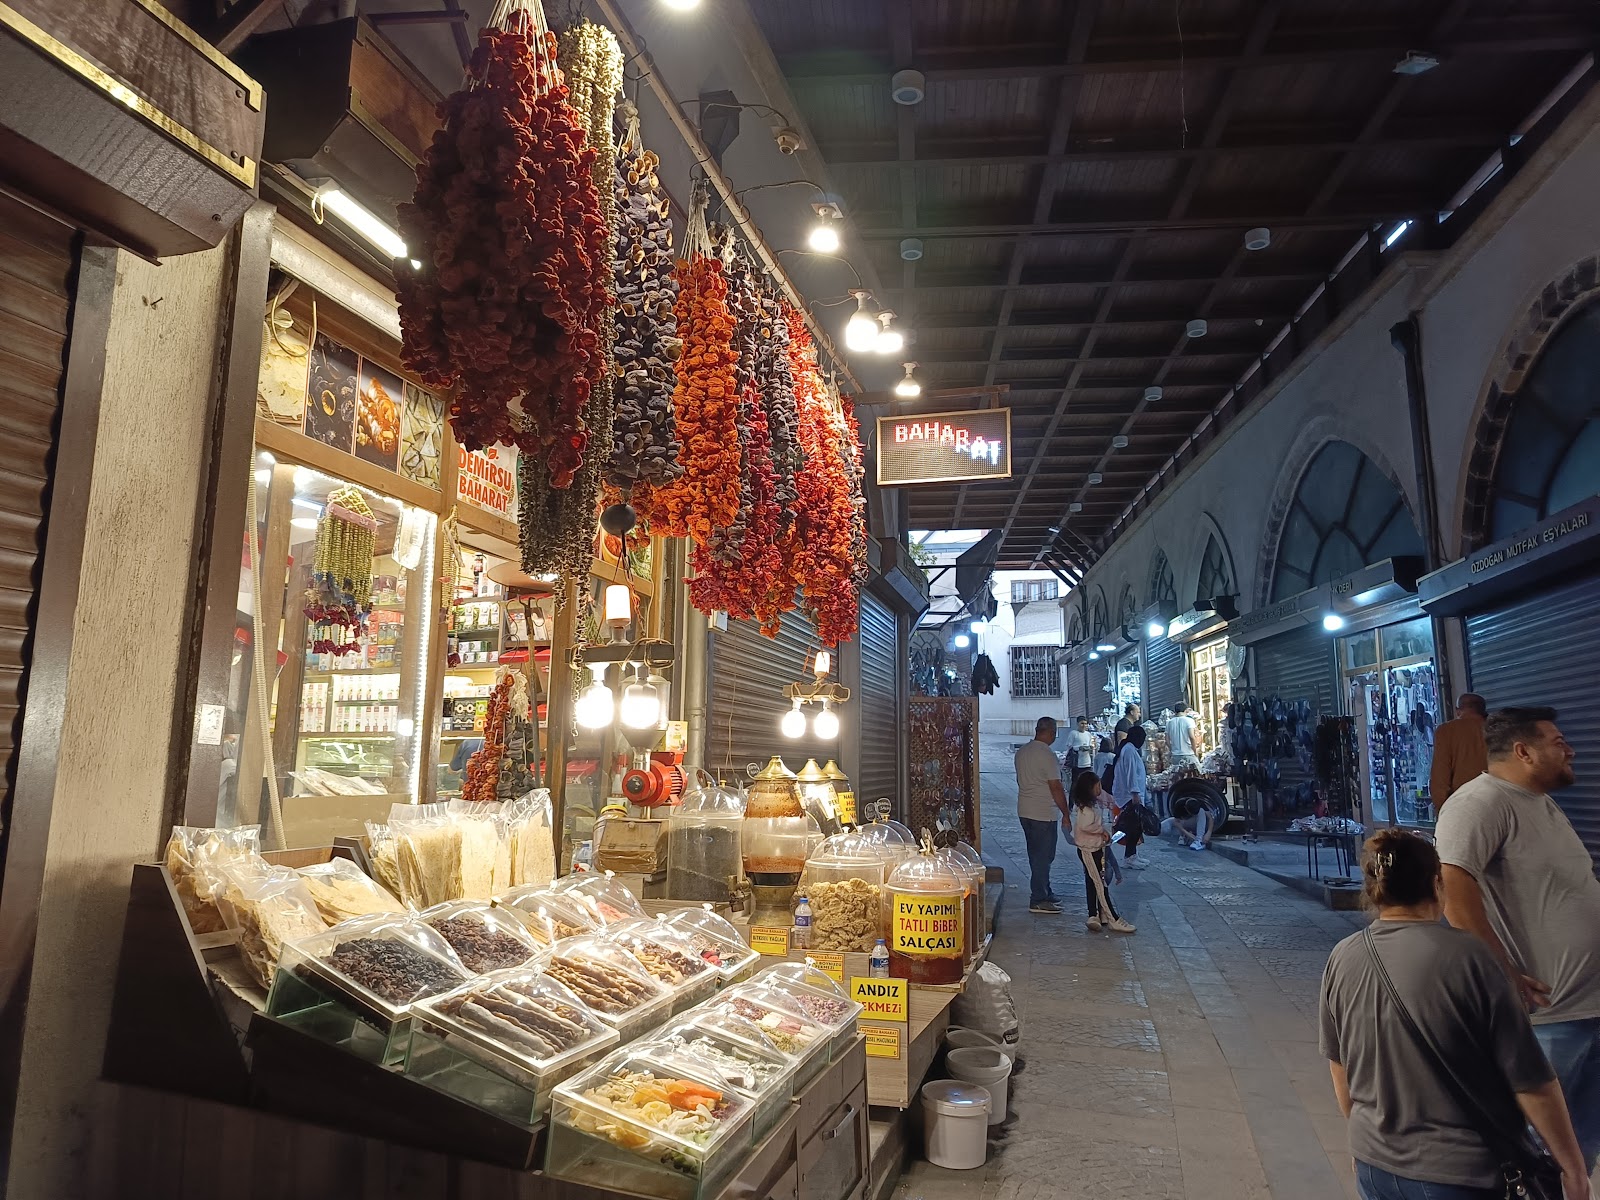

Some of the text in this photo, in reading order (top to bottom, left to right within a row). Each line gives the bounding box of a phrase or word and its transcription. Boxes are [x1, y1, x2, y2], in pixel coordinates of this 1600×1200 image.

[895, 421, 1002, 466] BAHARAT
[459, 475, 508, 513] BAHARAT
[1506, 534, 1539, 559] MUTFAK
[1542, 512, 1588, 543] EŞYALARI
[900, 903, 956, 915] EV YAPIMI
[900, 918, 929, 932] TATLI
[900, 935, 956, 951] SALÇASI
[857, 984, 899, 997] ANDIZ
[859, 1001, 902, 1013] EKMEZi
